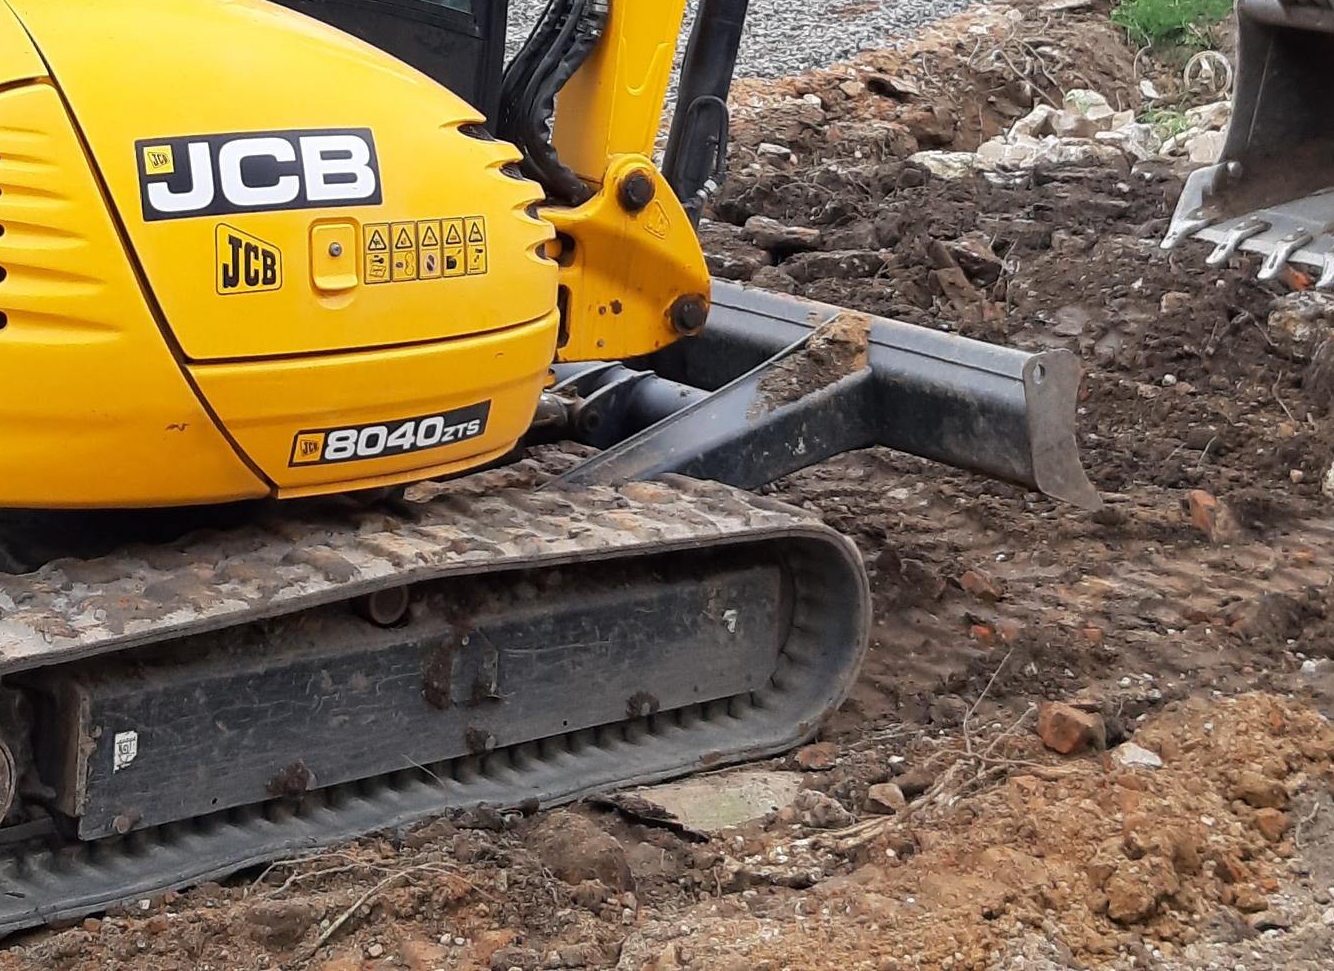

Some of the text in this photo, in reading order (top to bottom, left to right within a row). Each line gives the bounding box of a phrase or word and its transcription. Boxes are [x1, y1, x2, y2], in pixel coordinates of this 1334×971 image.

[147, 135, 375, 212] JCB
[222, 234, 276, 288] JCB
[324, 416, 445, 461] 8040
